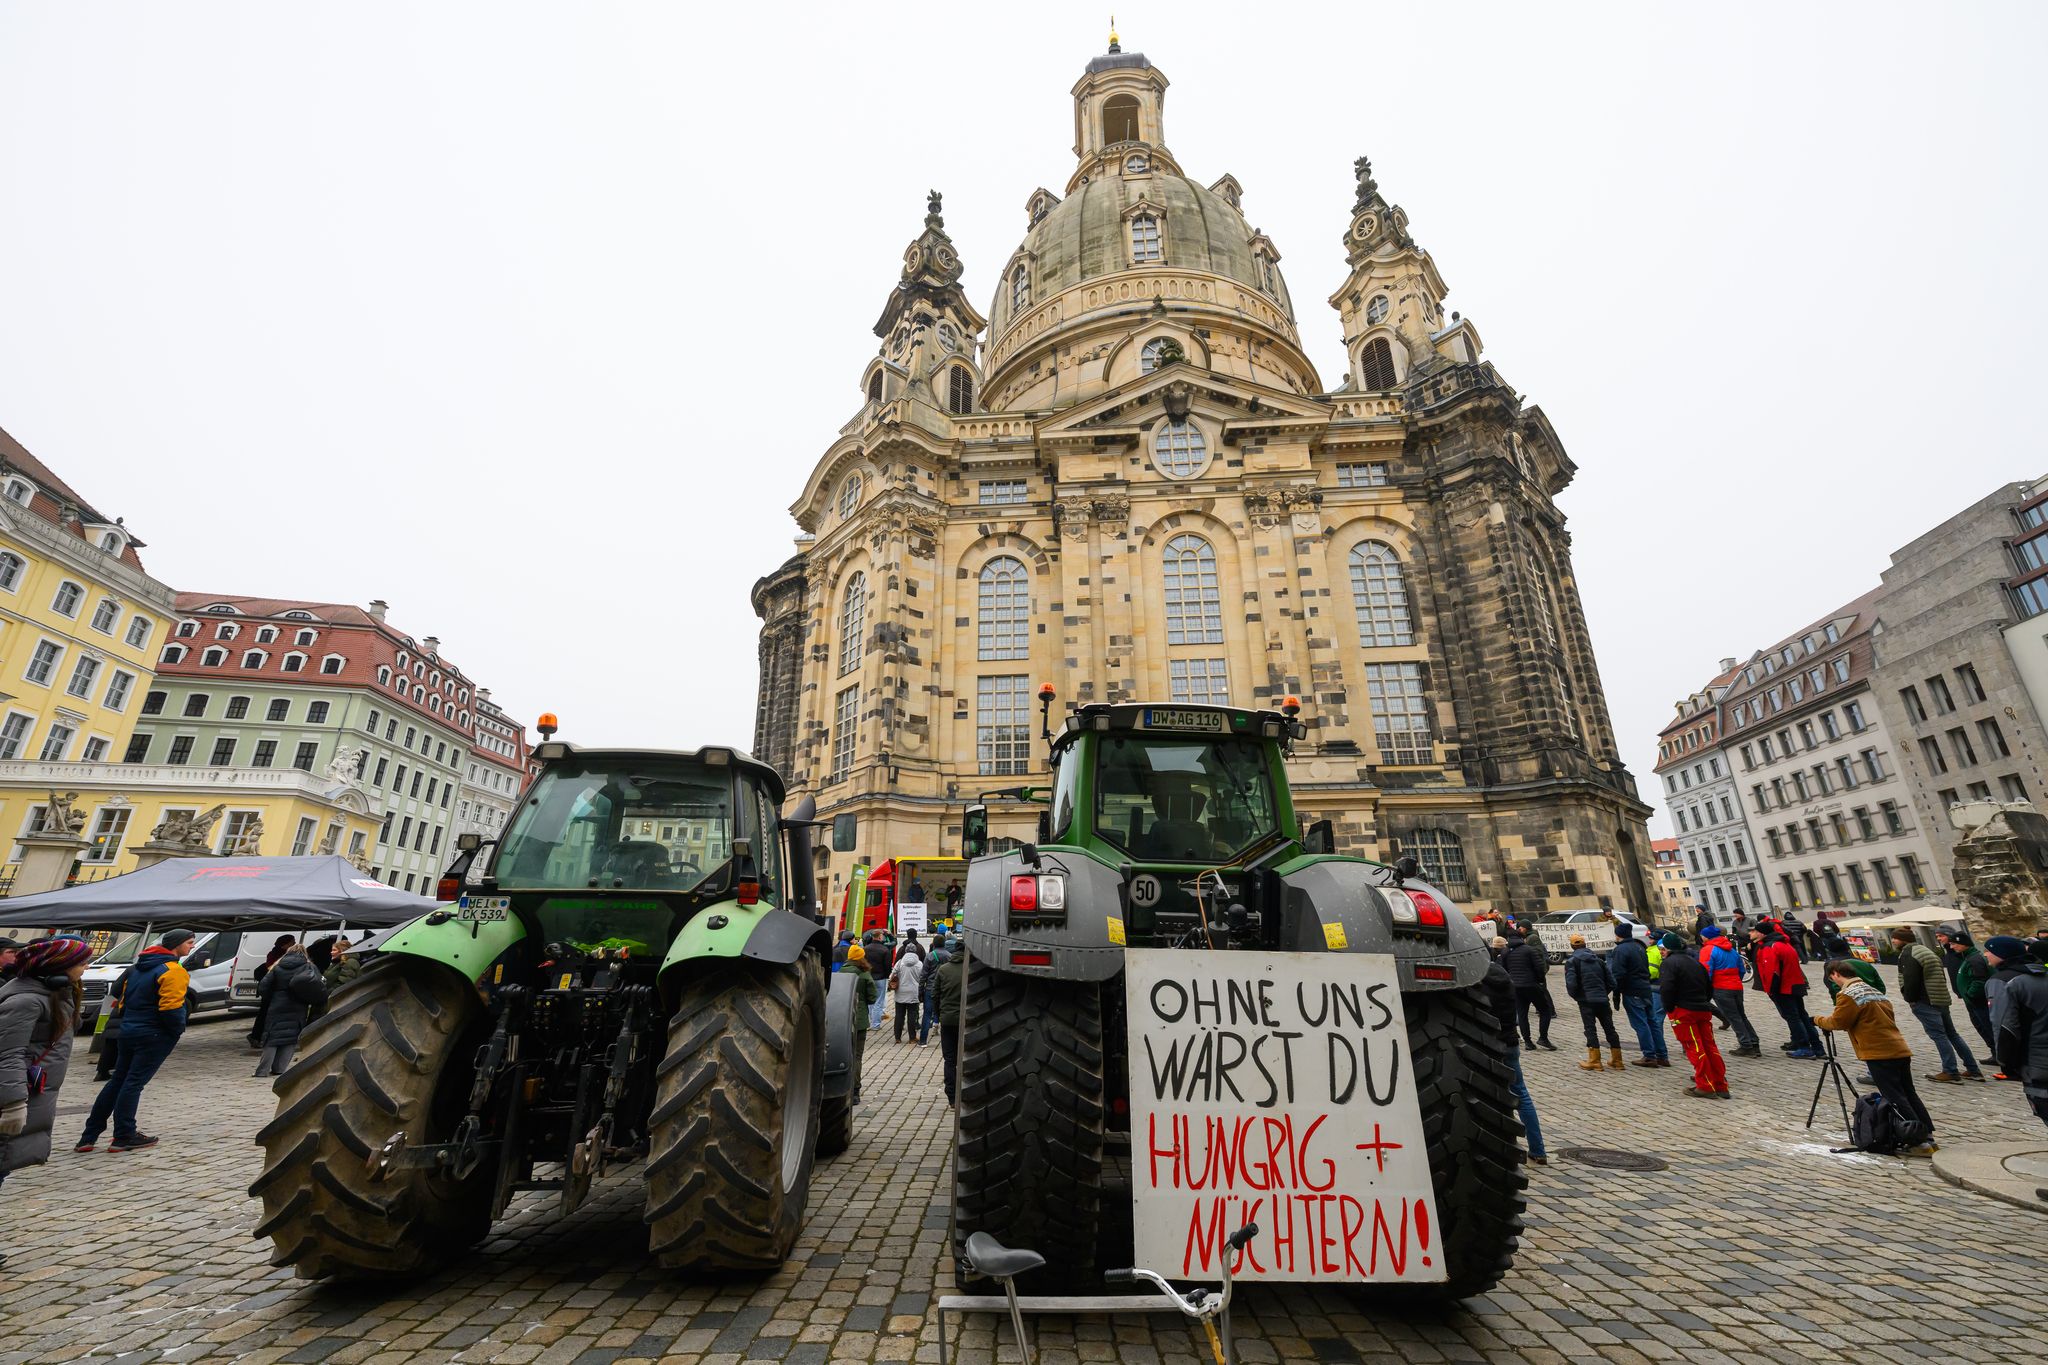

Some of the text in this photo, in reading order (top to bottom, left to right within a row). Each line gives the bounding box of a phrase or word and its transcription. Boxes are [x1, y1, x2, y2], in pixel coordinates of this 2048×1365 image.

[1152, 711, 1220, 726] DW AG 116
[468, 898, 490, 908] MEI
[1135, 880, 1155, 901] 50
[462, 909, 502, 919] CK 539
[1150, 979, 1393, 1030] OHNE UNS
[1144, 1026, 1399, 1108] WÄRST DU
[1149, 1112, 1403, 1192] HUNGRIG +
[1183, 1193, 1432, 1278] NÜCHTERN!
